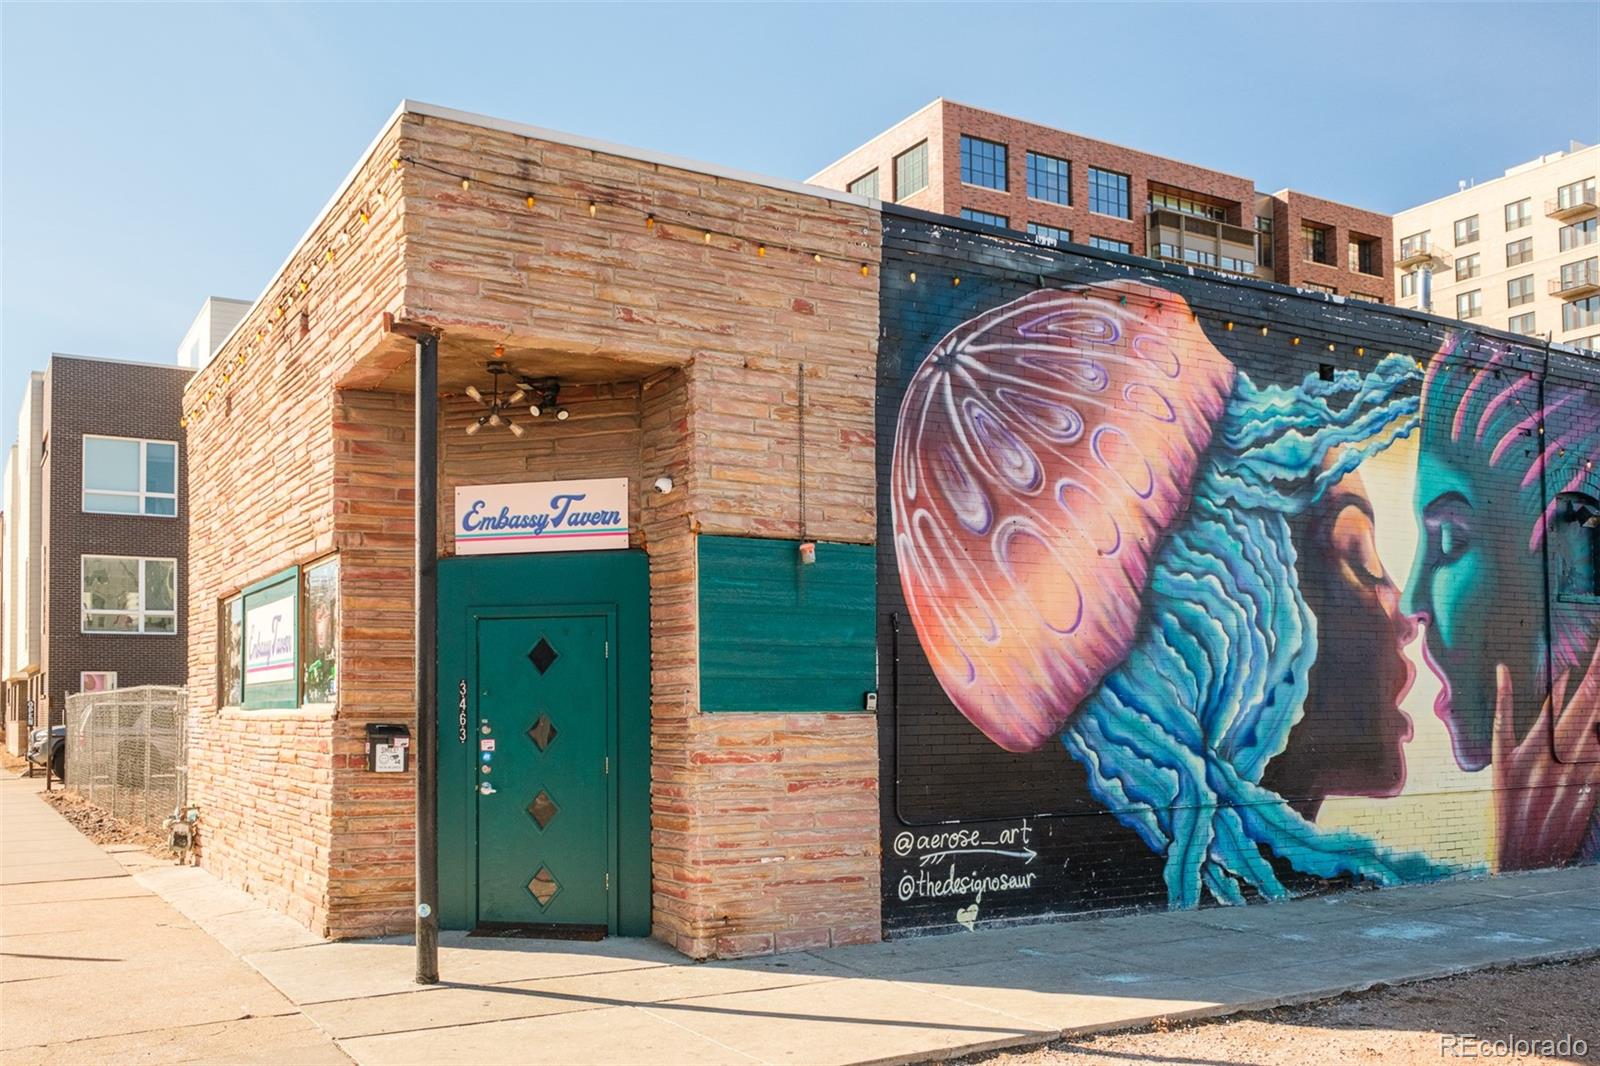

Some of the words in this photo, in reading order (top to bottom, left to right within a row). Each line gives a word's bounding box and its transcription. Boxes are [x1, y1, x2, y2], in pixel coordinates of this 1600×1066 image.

[462, 500, 549, 535] Embassy
[550, 494, 621, 528] Tavern
[459, 682, 467, 741] 3463
[894, 818, 1032, 857] @aerose_art
[898, 863, 1037, 904] @thedesignosaur
